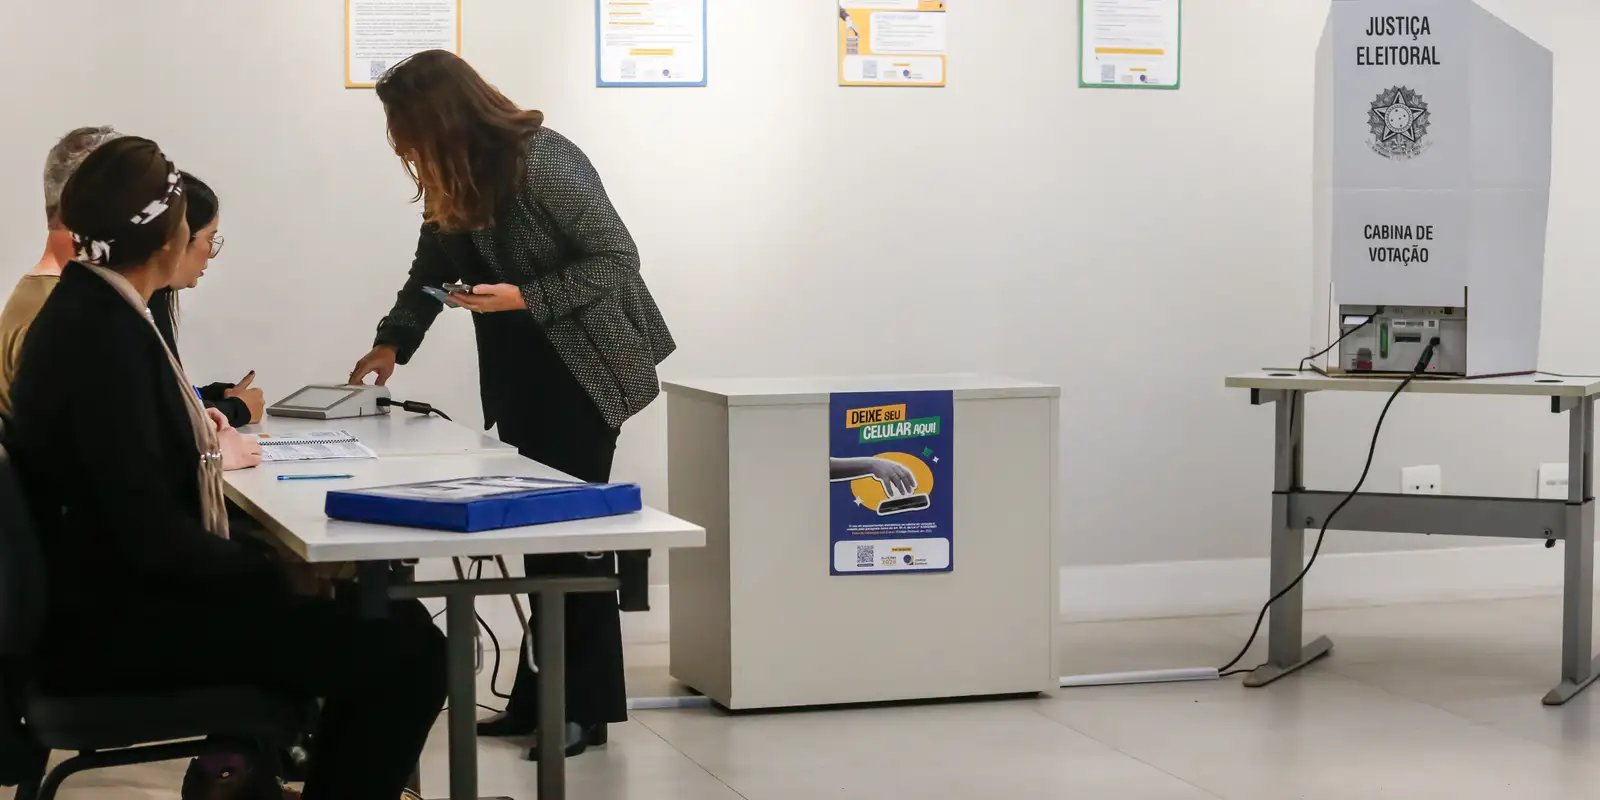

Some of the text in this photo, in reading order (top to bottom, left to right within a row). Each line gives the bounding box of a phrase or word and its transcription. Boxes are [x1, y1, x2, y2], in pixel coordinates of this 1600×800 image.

[1366, 16, 1431, 40] JUSTIÇA
[1356, 46, 1441, 66] ELEITORAL
[1363, 224, 1434, 241] CABINA DE
[1368, 244, 1429, 266] VOTAÇÃO
[851, 409, 901, 424] DEIXE SEU
[862, 422, 937, 440] CELULAR AQUI!
